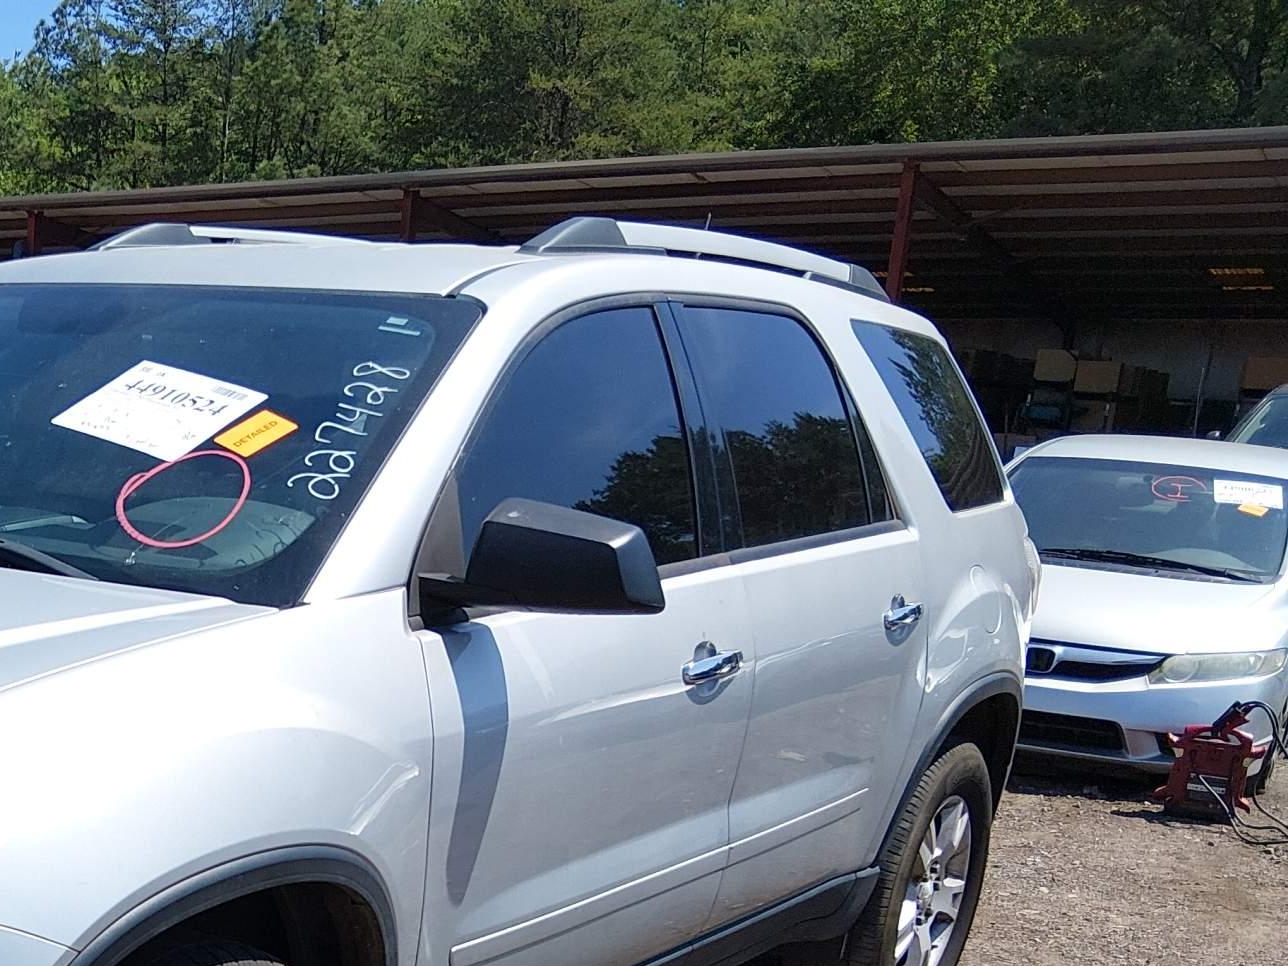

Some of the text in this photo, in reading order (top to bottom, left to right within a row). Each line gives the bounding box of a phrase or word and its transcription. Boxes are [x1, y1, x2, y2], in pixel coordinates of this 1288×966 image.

[124, 379, 230, 416] 44910524
[232, 420, 279, 449] DETAILED
[286, 360, 411, 500] 227428
